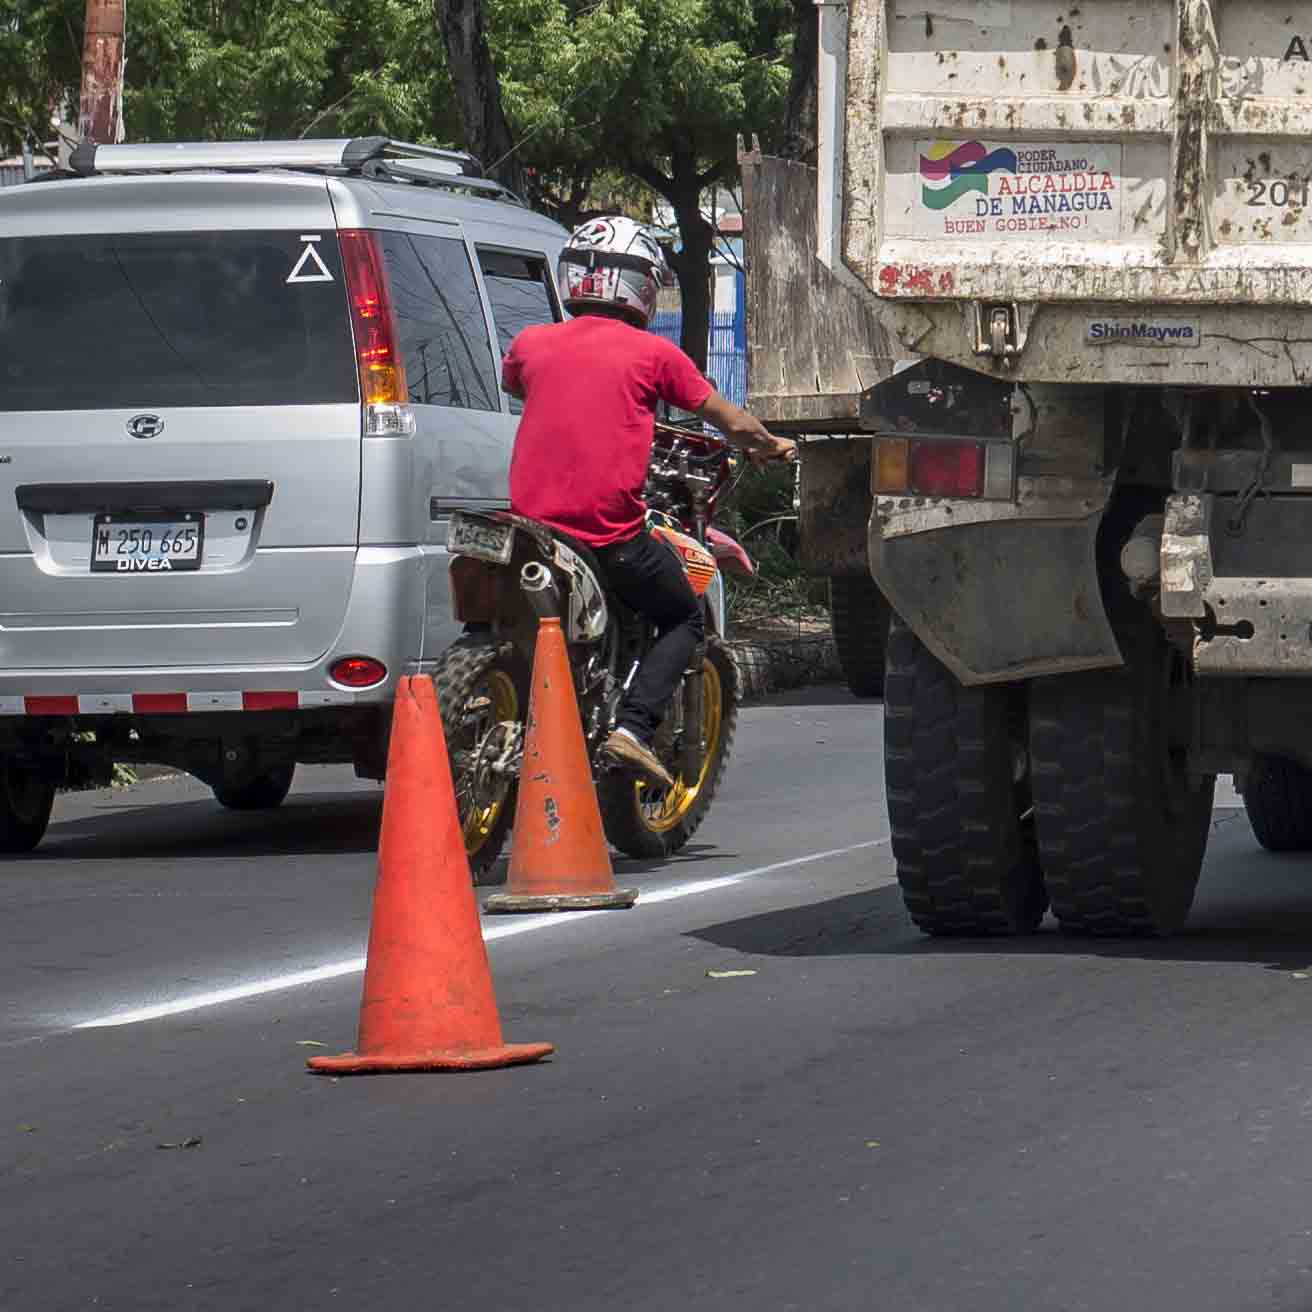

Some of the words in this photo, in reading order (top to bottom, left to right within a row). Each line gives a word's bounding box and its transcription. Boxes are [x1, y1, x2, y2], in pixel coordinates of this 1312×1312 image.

[1017, 149, 1057, 162] PODER
[998, 163, 1115, 196] ALCALDÍA
[976, 197, 1003, 217] DE
[1012, 192, 1113, 215] MANAGUA
[1090, 322, 1194, 341] ShinMaywa
[116, 529, 153, 555] 250
[160, 528, 197, 555] 665
[116, 558, 173, 571] DIVEA
